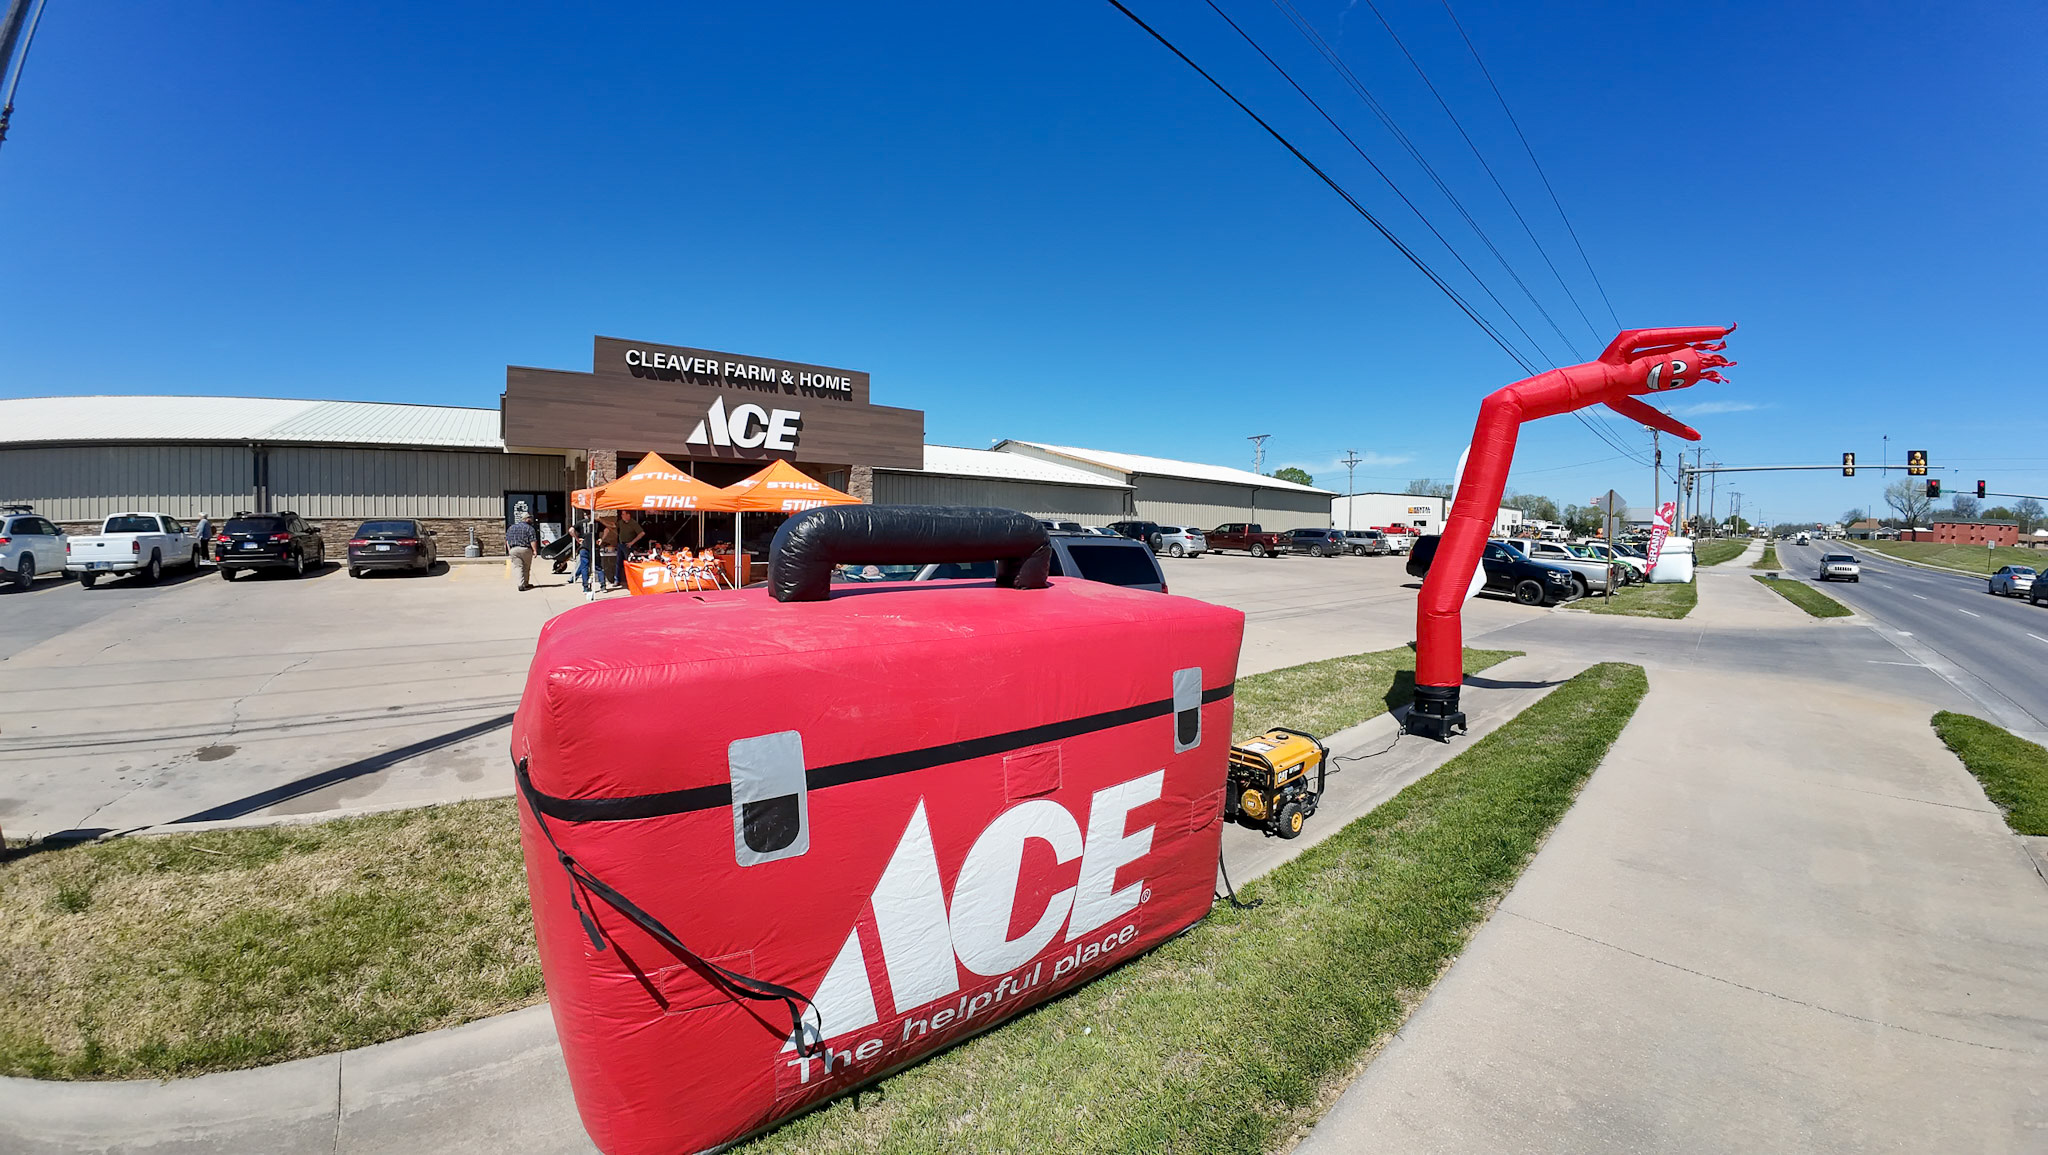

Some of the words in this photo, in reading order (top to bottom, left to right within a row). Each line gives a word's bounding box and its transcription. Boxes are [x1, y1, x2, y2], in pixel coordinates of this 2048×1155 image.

[625, 349, 719, 376] CLEAVER
[724, 361, 776, 383] FARM
[780, 369, 795, 385] &
[799, 372, 851, 392] HOME
[685, 394, 801, 451] ACE
[630, 471, 692, 483] STIHL
[766, 481, 820, 491] STIHL
[642, 495, 697, 509] STIHL
[1647, 527, 1662, 565] GRAND
[779, 768, 1165, 1054] ACE
[787, 1038, 884, 1084] The
[901, 961, 1043, 1043] helpful
[1051, 923, 1140, 982] place.
